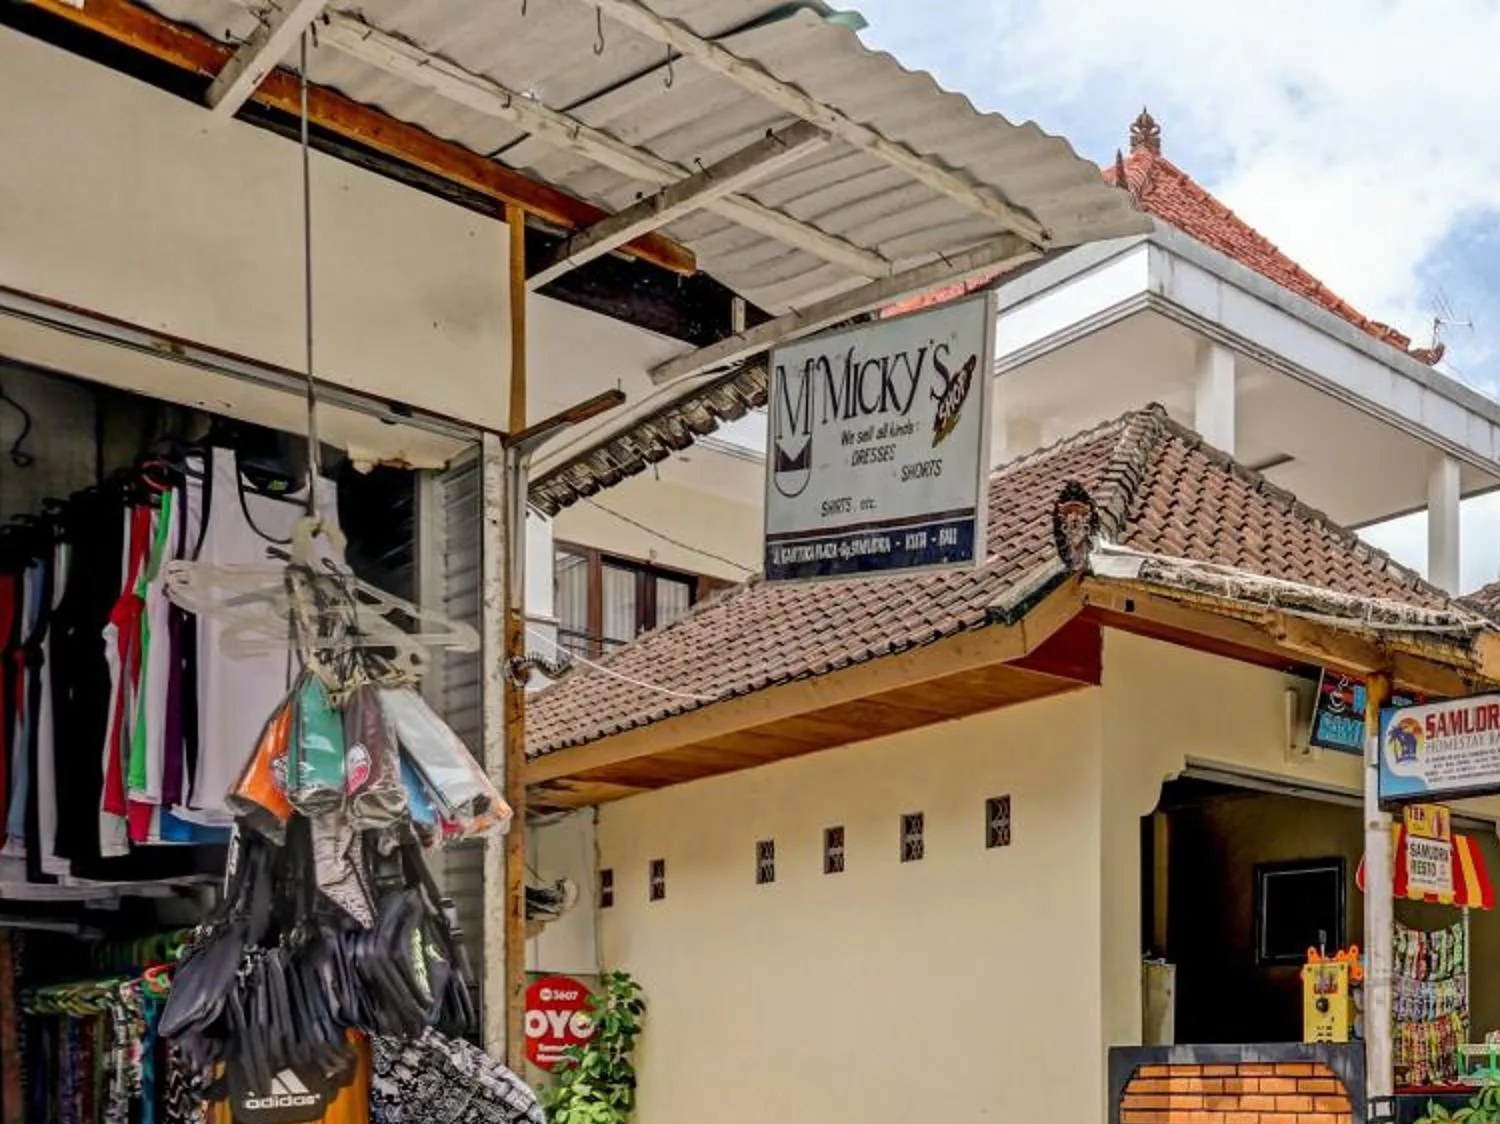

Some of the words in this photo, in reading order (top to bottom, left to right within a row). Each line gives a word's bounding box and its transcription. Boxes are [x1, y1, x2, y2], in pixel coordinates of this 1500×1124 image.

[851, 444, 896, 467] DRESSES
[901, 459, 942, 482] SHORTS
[1410, 842, 1449, 862] SAMUDRA
[1410, 860, 1437, 877] RESTO
[525, 1009, 595, 1038] OYO
[245, 1093, 315, 1109] adidas
